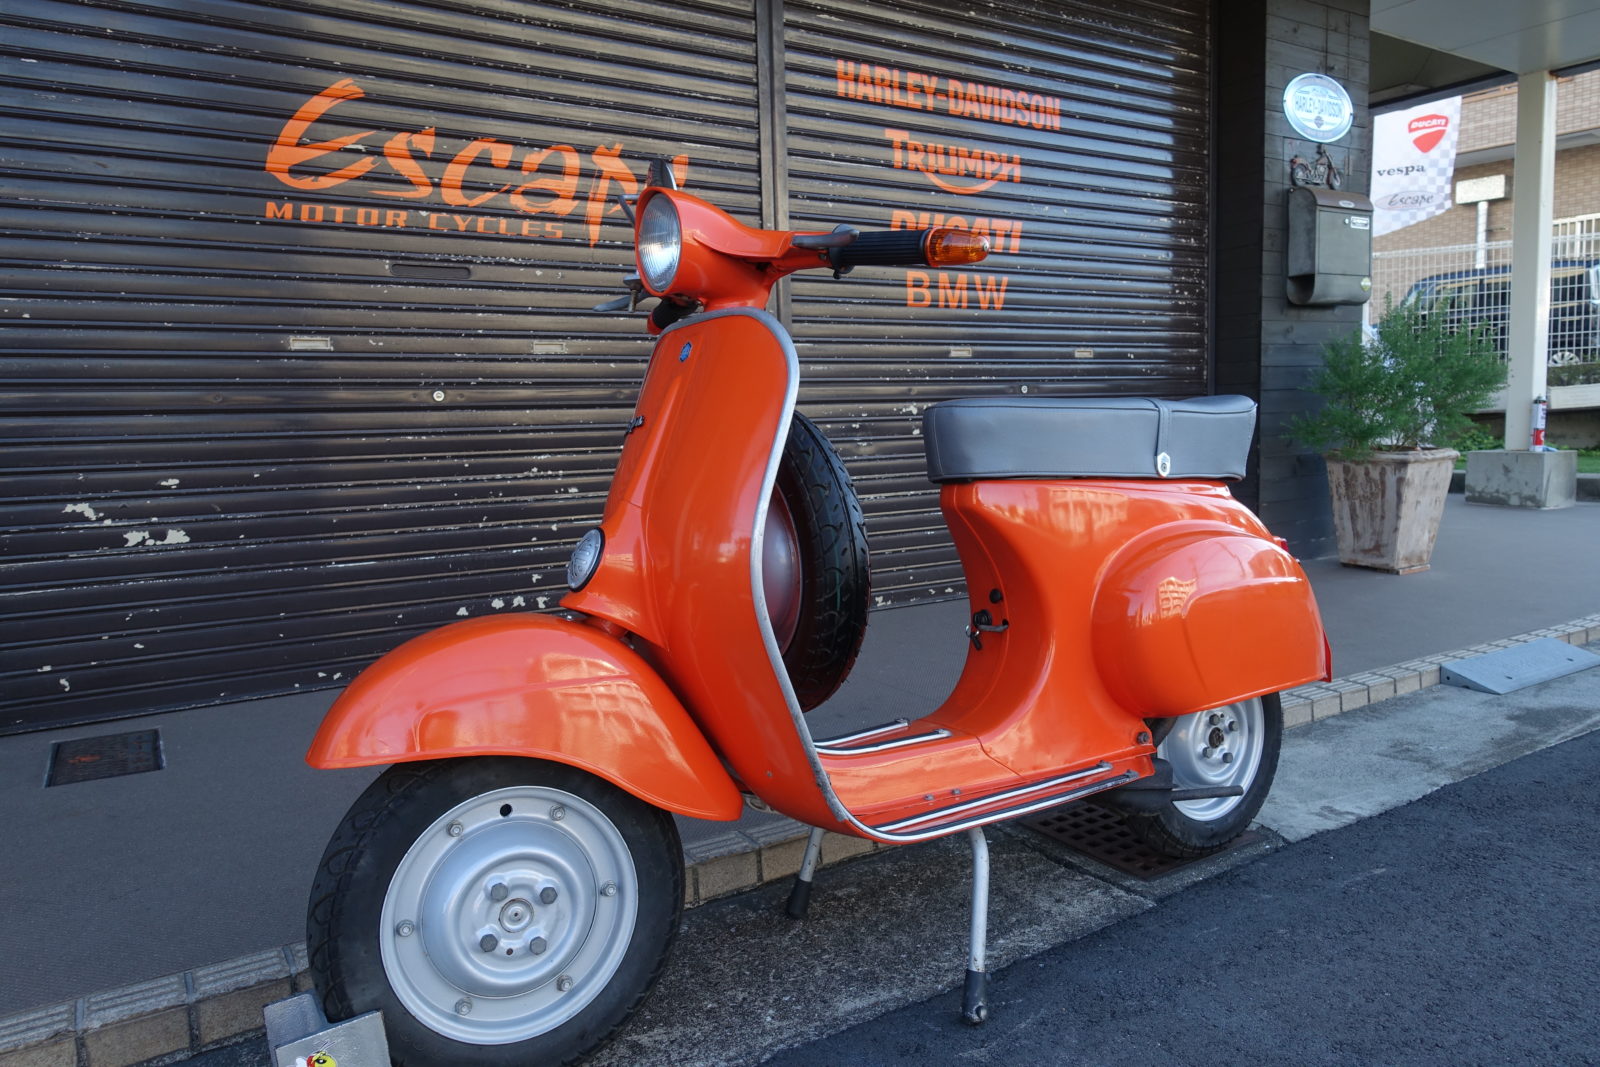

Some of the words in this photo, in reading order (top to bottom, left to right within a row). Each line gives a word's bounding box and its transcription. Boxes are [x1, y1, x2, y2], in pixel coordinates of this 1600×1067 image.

[836, 59, 1061, 131] HARLEY-DAVIDSON
[1410, 118, 1446, 129] DUCATI
[264, 77, 689, 248] Escap
[1377, 164, 1425, 177] vespa
[1388, 193, 1434, 207] Escape
[265, 201, 407, 228] MOTOR
[428, 212, 564, 240] CYCLES
[906, 270, 1009, 311] BMW
